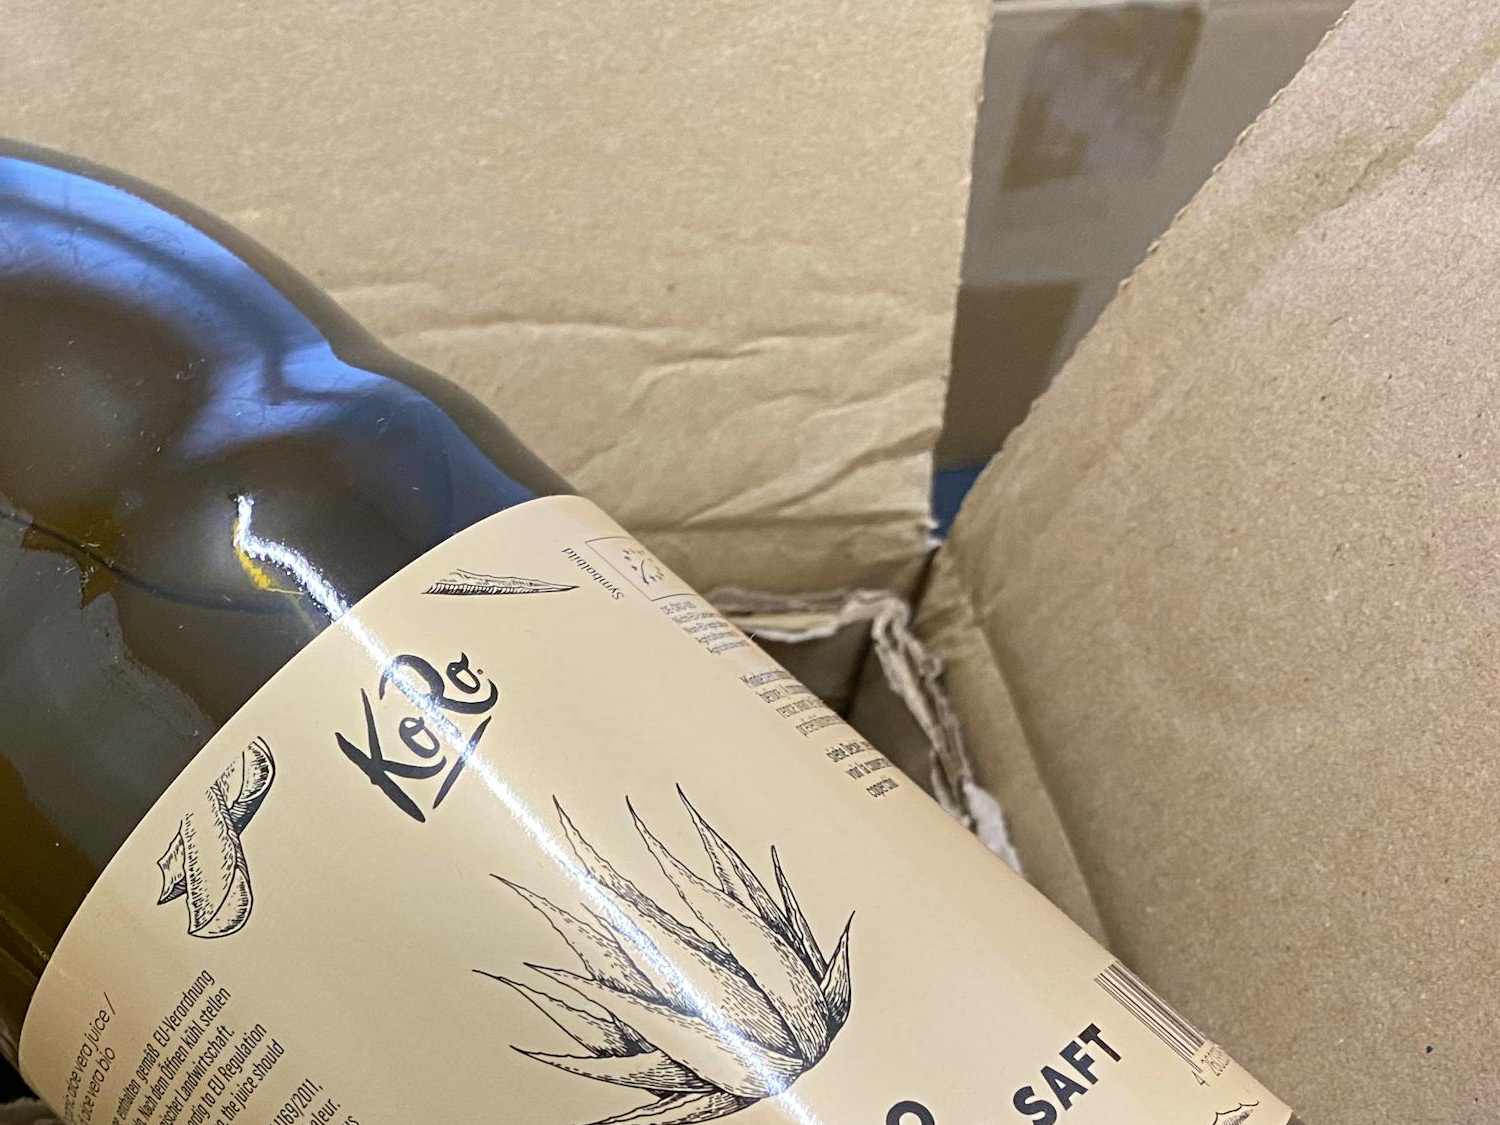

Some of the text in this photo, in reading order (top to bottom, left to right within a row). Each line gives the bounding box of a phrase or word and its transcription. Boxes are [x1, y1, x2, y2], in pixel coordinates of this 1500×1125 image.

[561, 547, 626, 600] Symbolbild
[335, 652, 499, 823] KoRo
[199, 987, 232, 1028] stellen
[74, 1042, 93, 1074] vera
[84, 1009, 111, 1053] juice
[116, 1078, 142, 1121] enthalten
[135, 1042, 161, 1085] gemäß
[152, 969, 216, 1048] EU-Verordnung
[180, 1019, 206, 1050] kühl
[94, 1047, 116, 1073] bio
[157, 1045, 190, 1081] Öffnen
[174, 1025, 235, 1103] Landwirtschaft.
[217, 1023, 268, 1083] Regulation
[252, 1038, 285, 1081] should
[88, 1068, 105, 1098] vera
[149, 1075, 170, 1101] dem
[200, 1092, 217, 1108] to
[207, 1074, 226, 1097] EU
[229, 1076, 258, 1110] juice
[137, 1094, 158, 1122] Nach
[220, 1100, 241, 1122] the
